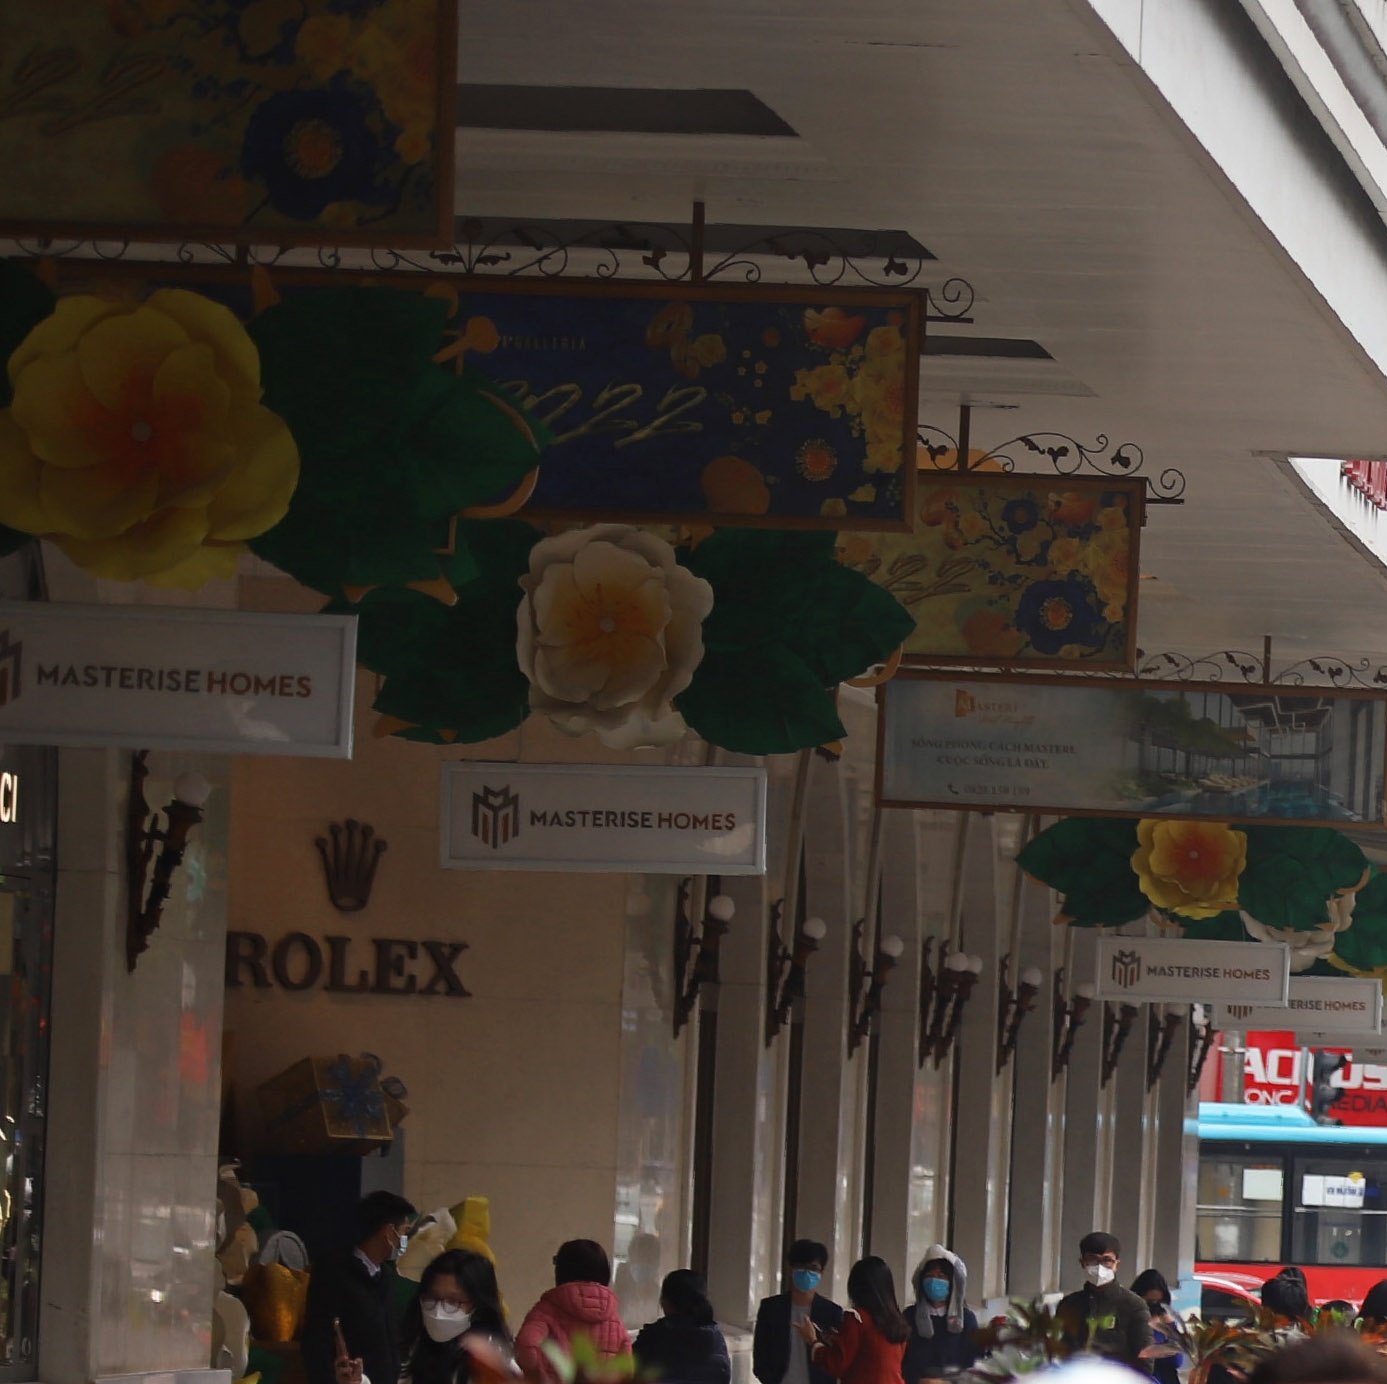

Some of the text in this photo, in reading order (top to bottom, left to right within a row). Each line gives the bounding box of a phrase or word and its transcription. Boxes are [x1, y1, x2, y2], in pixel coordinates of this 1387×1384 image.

[37, 663, 312, 698] MASTERISE HOMES
[529, 809, 737, 831] MASTERISE HOMES
[225, 931, 473, 997] ROLEX
[1145, 964, 1271, 982] MASTERISE HOMES
[1288, 999, 1366, 1012] ERISE HOMES
